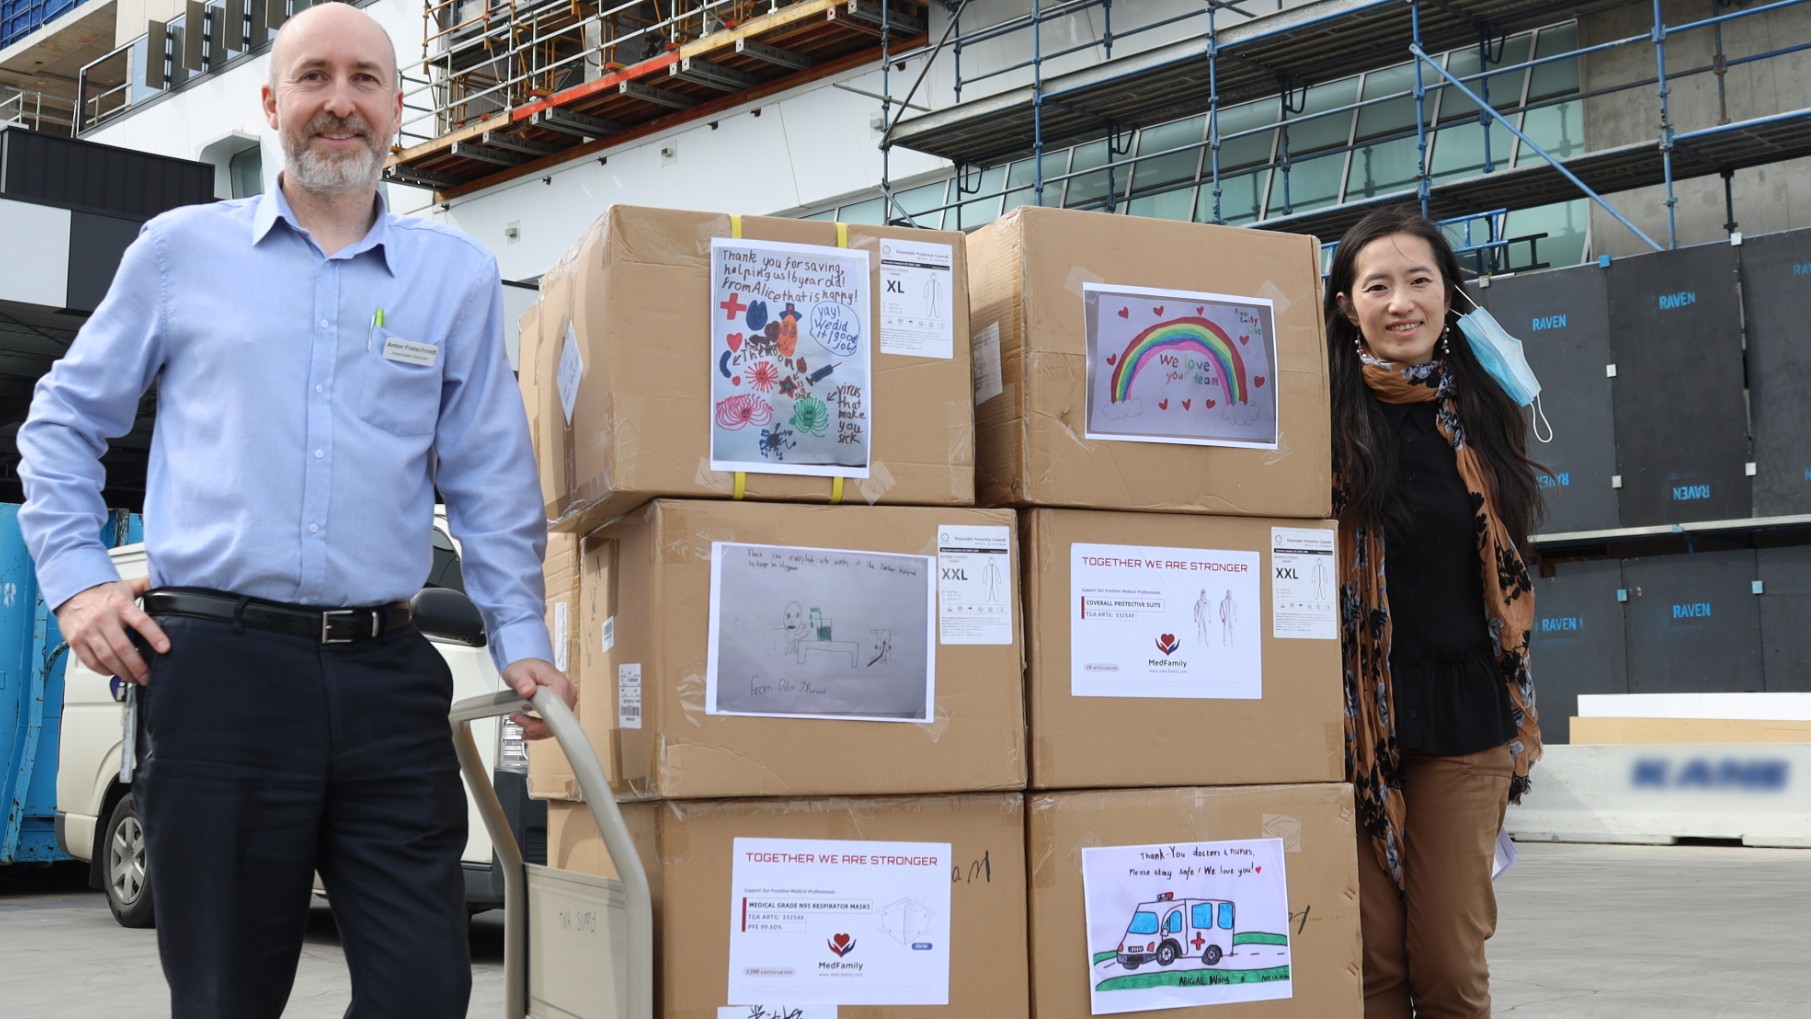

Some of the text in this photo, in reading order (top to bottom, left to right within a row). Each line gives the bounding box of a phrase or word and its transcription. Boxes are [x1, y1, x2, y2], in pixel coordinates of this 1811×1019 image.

[723, 250, 844, 278] Thank you for saving,
[724, 264, 770, 281] helping
[798, 276, 821, 288] year
[722, 277, 858, 305] from Alice that is happy!
[887, 280, 904, 293] XL
[1659, 292, 1696, 309] RAVEN
[814, 319, 848, 332] We did
[1532, 314, 1566, 331] RAVEN
[1160, 354, 1210, 372] We love
[1194, 372, 1219, 385] team
[837, 383, 860, 398] virus
[838, 400, 860, 410] that
[838, 410, 865, 419] make
[839, 421, 862, 433] you
[838, 432, 860, 444] sick
[1673, 485, 1710, 500] RAVEN
[1082, 556, 1248, 572] TOGETHER WE ARE STRONGER
[942, 568, 968, 580] XXL
[1276, 568, 1299, 579] XXL
[1673, 603, 1711, 619] RAVEN
[1542, 618, 1576, 632] RAVEN
[1148, 659, 1187, 668] MedFamily
[1632, 759, 1789, 789] KANE
[746, 852, 938, 866] TOGETHER WE ARE STRONGER
[1140, 847, 1185, 860] Thank-You
[1193, 847, 1220, 857] doctors
[1230, 848, 1255, 857] nurses,
[1129, 868, 1150, 876] Please
[1154, 868, 1172, 880] stay
[1204, 866, 1216, 875] We
[1220, 865, 1234, 874] love
[1237, 862, 1254, 877] you!
[819, 962, 863, 971] MedFamily
[1209, 976, 1229, 984] Wong
